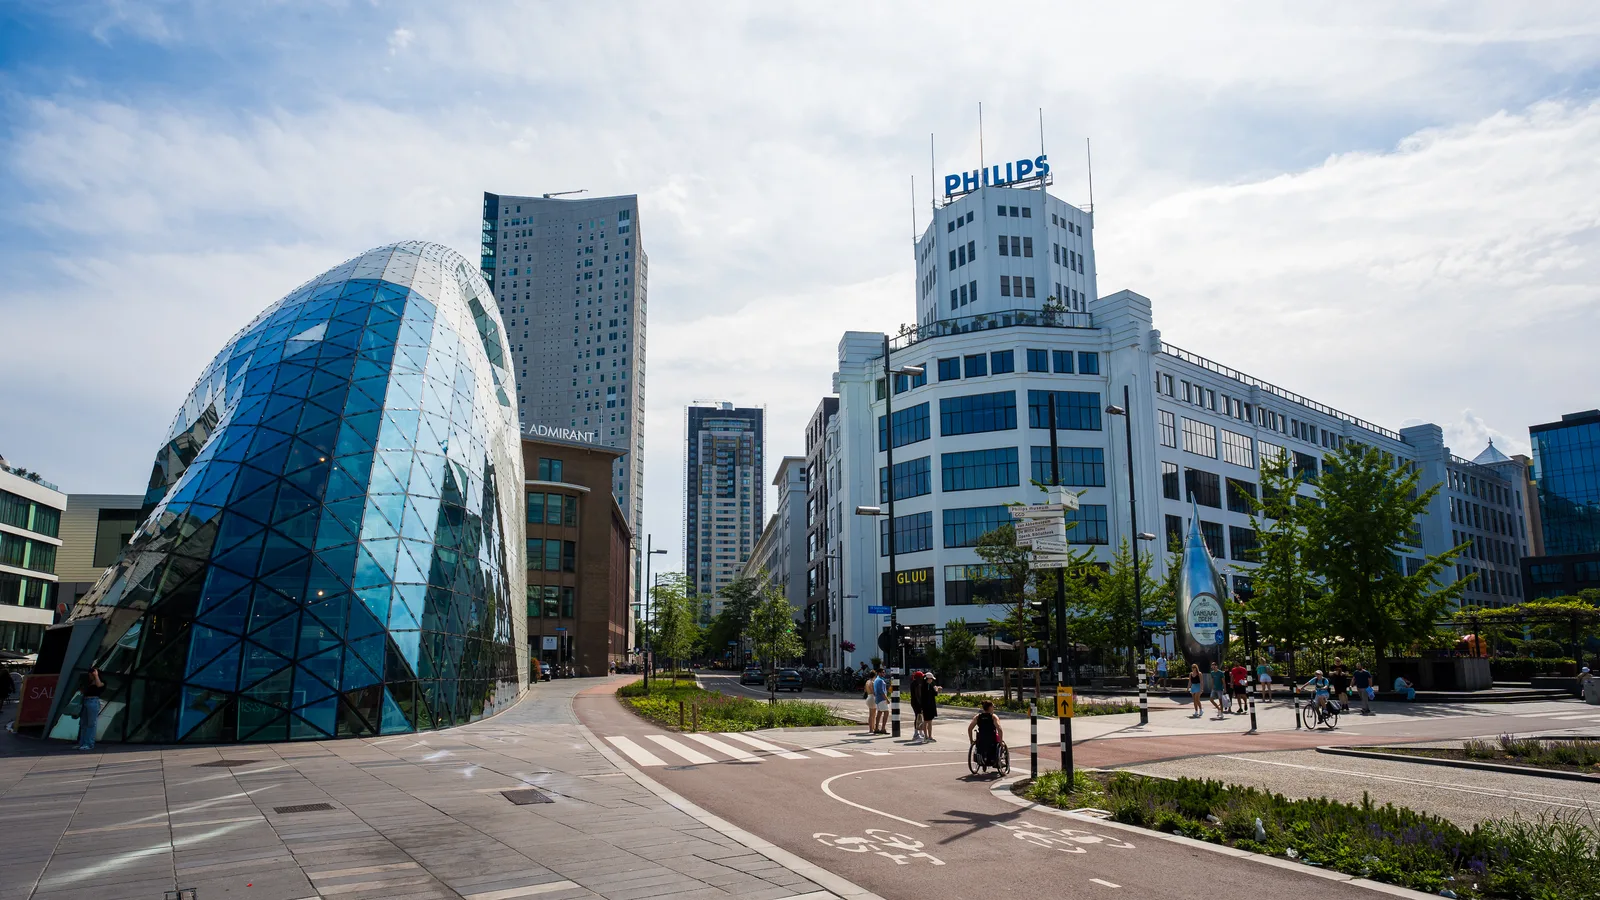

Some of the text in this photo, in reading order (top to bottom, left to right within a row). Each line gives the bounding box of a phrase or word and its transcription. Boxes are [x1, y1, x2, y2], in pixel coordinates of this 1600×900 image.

[945, 154, 1050, 196] PHILIPS
[528, 423, 595, 443] ADMIRANT
[897, 569, 927, 585] GLUU
[29, 686, 55, 699] SAL
